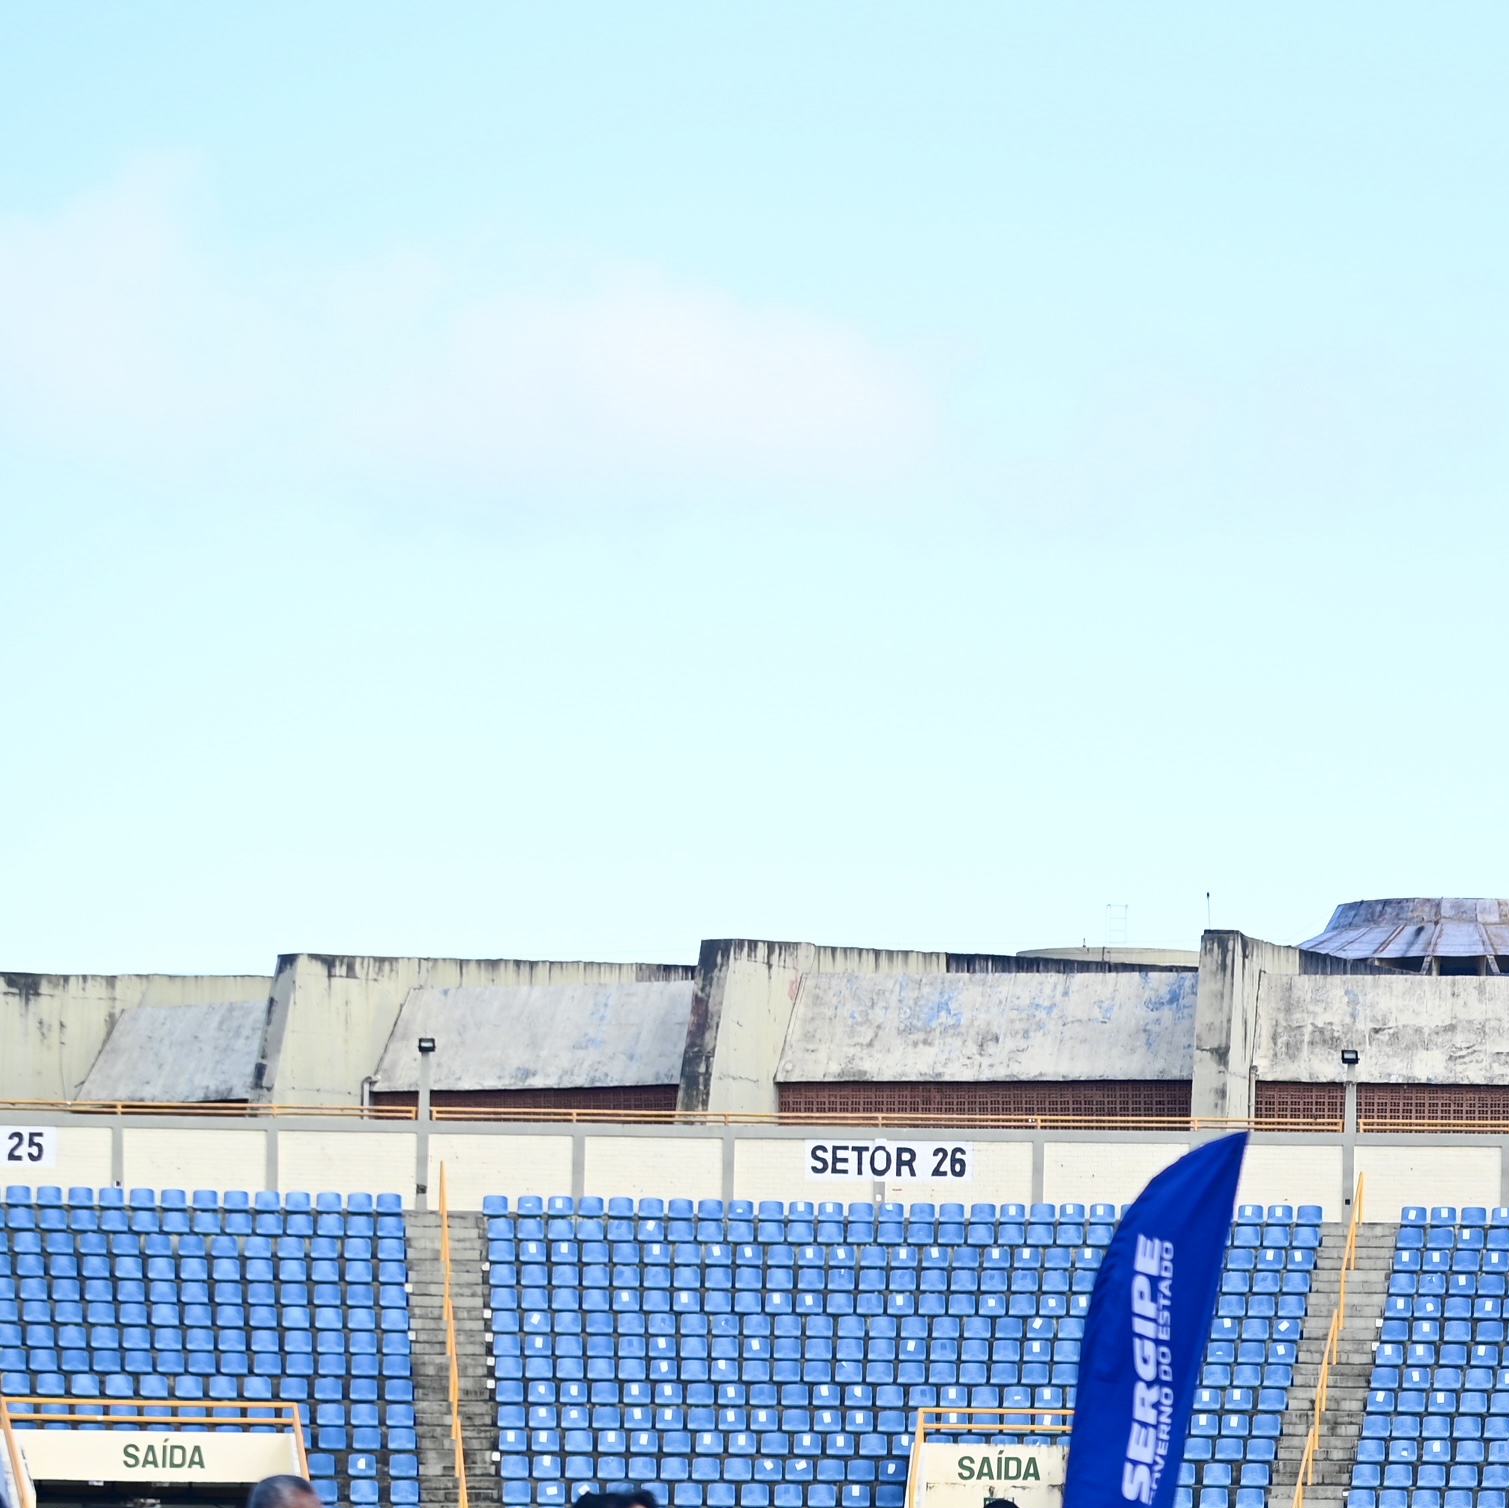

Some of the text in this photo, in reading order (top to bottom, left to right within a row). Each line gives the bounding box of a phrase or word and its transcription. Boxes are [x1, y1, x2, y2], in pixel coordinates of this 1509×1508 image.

[7, 1131, 44, 1162] 25
[811, 1144, 967, 1177] SETOR 26
[1155, 1240, 1174, 1341] ESTADO
[1121, 1233, 1162, 1505] SERGIPE
[1158, 1346, 1174, 1381] DO
[123, 1438, 206, 1468] SAÍDA
[958, 1450, 1041, 1481] SAÍDA
